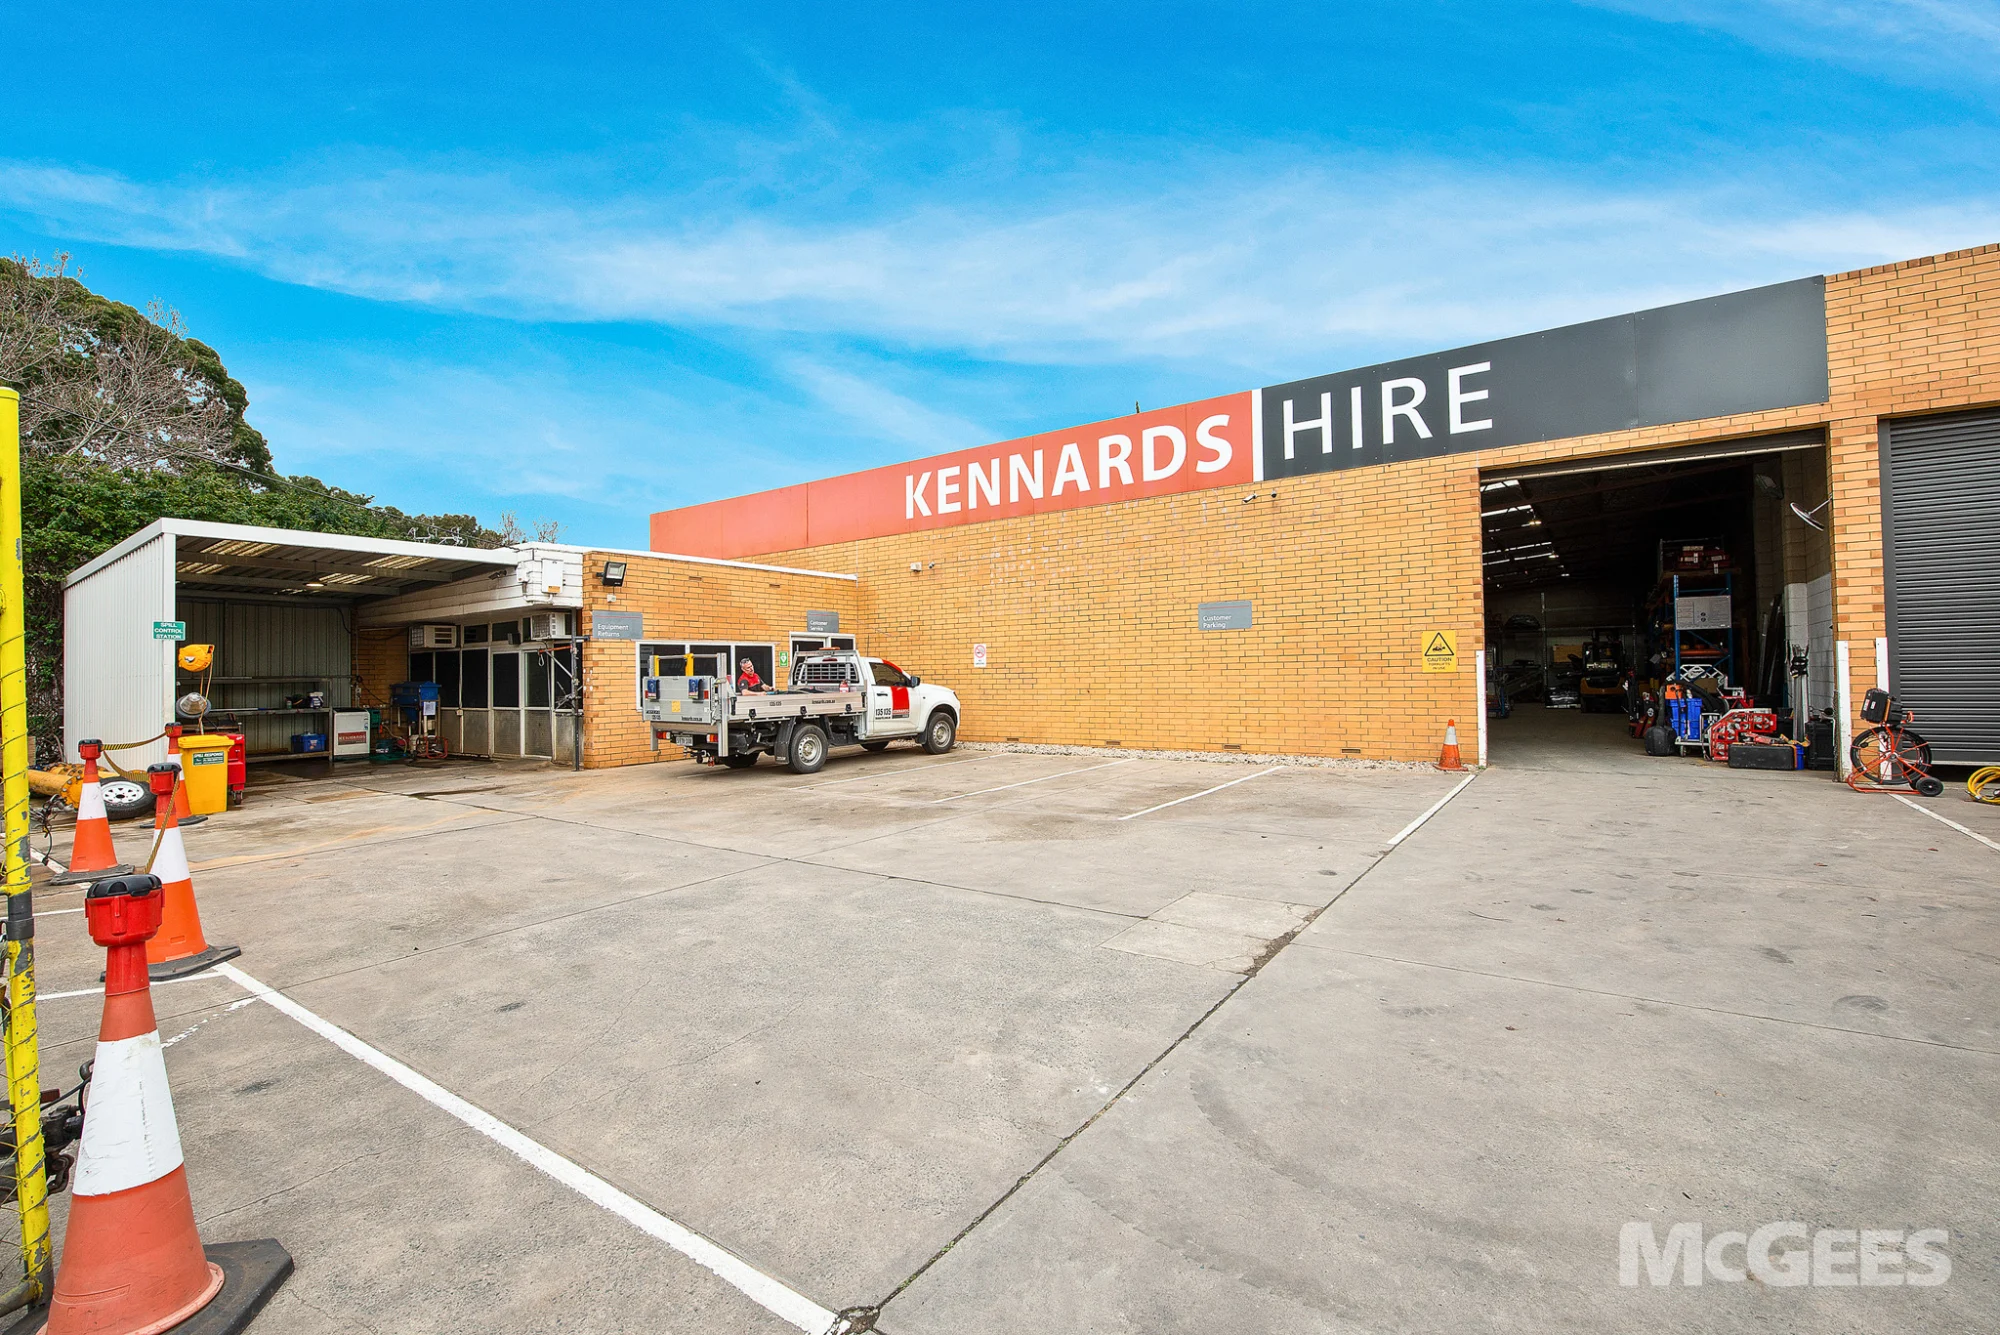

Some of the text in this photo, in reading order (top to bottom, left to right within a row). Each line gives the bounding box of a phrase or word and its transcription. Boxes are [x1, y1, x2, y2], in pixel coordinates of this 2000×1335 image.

[905, 361, 1493, 519] KENNARDS HIRE
[597, 623, 629, 631] Equipment
